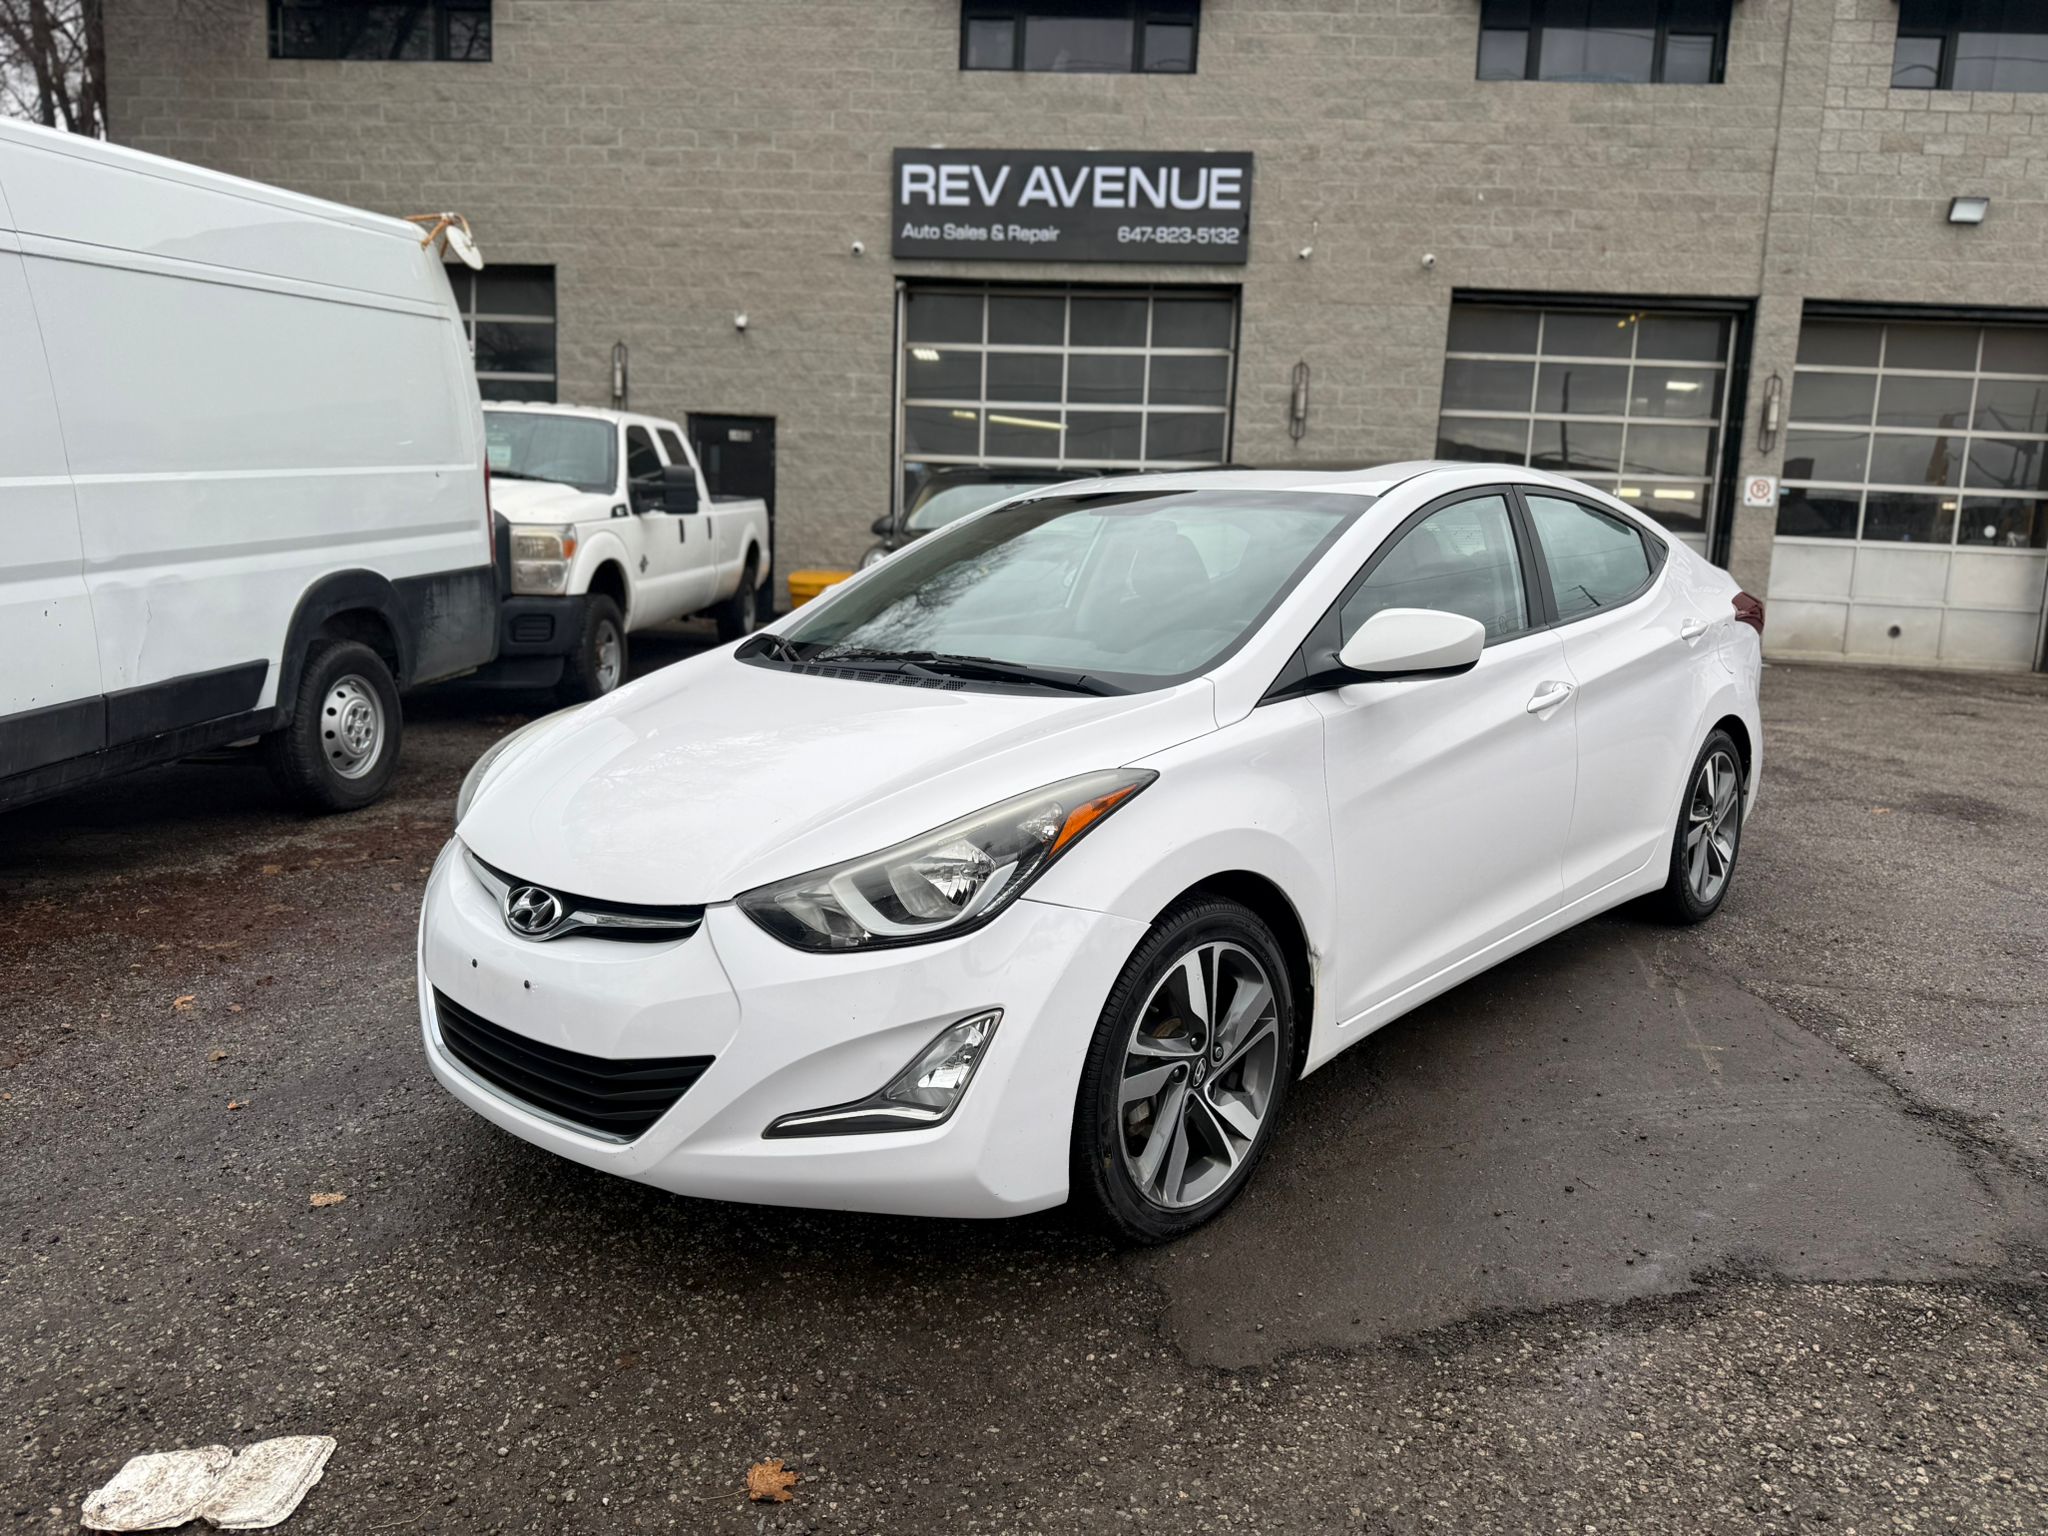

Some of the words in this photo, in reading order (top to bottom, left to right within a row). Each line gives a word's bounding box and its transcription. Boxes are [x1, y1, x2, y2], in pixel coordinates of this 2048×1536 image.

[901, 164, 1010, 207] REV
[1018, 166, 1243, 210] AVENUE
[901, 222, 940, 240] Auto
[943, 223, 988, 241] Sales
[991, 224, 1005, 241] &
[1008, 224, 1060, 244] Repair
[1117, 226, 1240, 244] 647-823-5132
